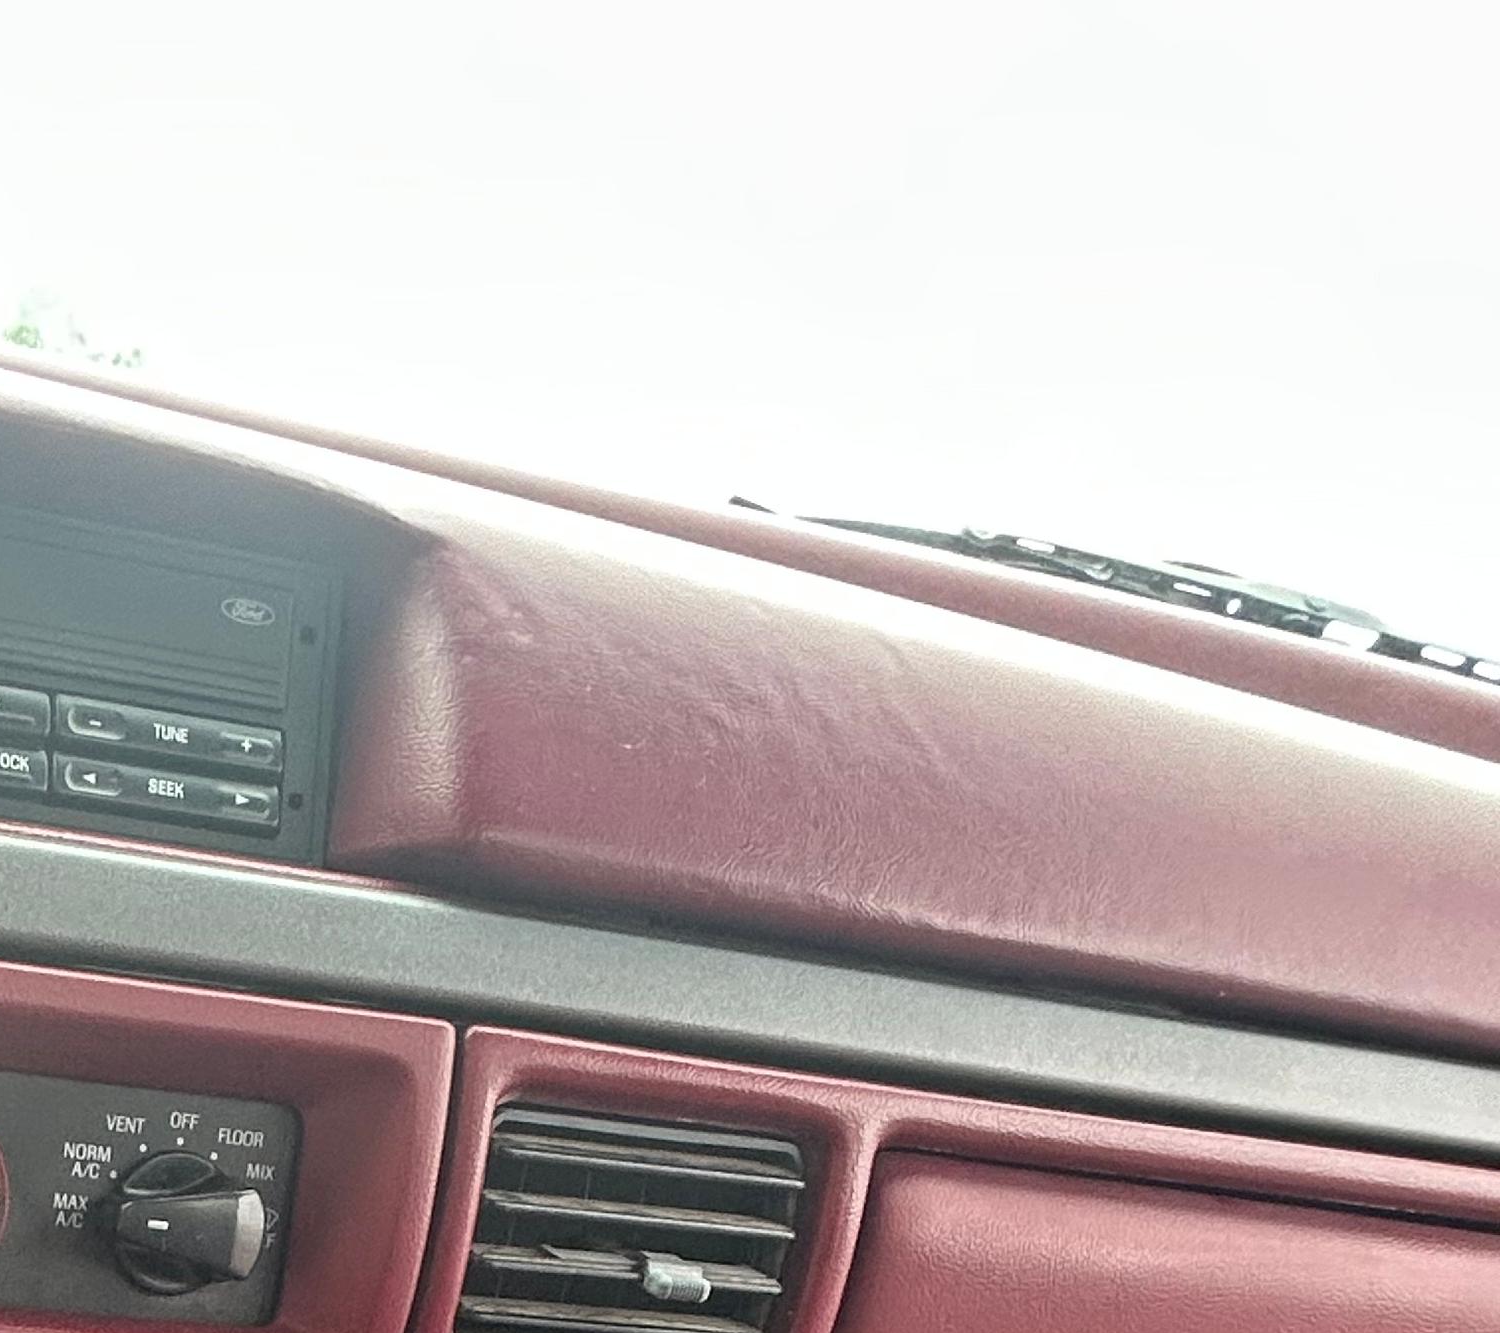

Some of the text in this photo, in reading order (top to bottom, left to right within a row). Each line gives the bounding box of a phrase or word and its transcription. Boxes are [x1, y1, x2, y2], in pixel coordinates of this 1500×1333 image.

[153, 723, 189, 745] TUNE
[147, 777, 186, 800] SEEK
[105, 1113, 146, 1135] VENT
[169, 1111, 200, 1130] OFF
[217, 1127, 265, 1148] FLOOR
[63, 1141, 112, 1163] NORM
[70, 1161, 101, 1180] A/C
[245, 1162, 276, 1181] MIX
[52, 1192, 89, 1211] MAX
[54, 1210, 85, 1228] A/C
